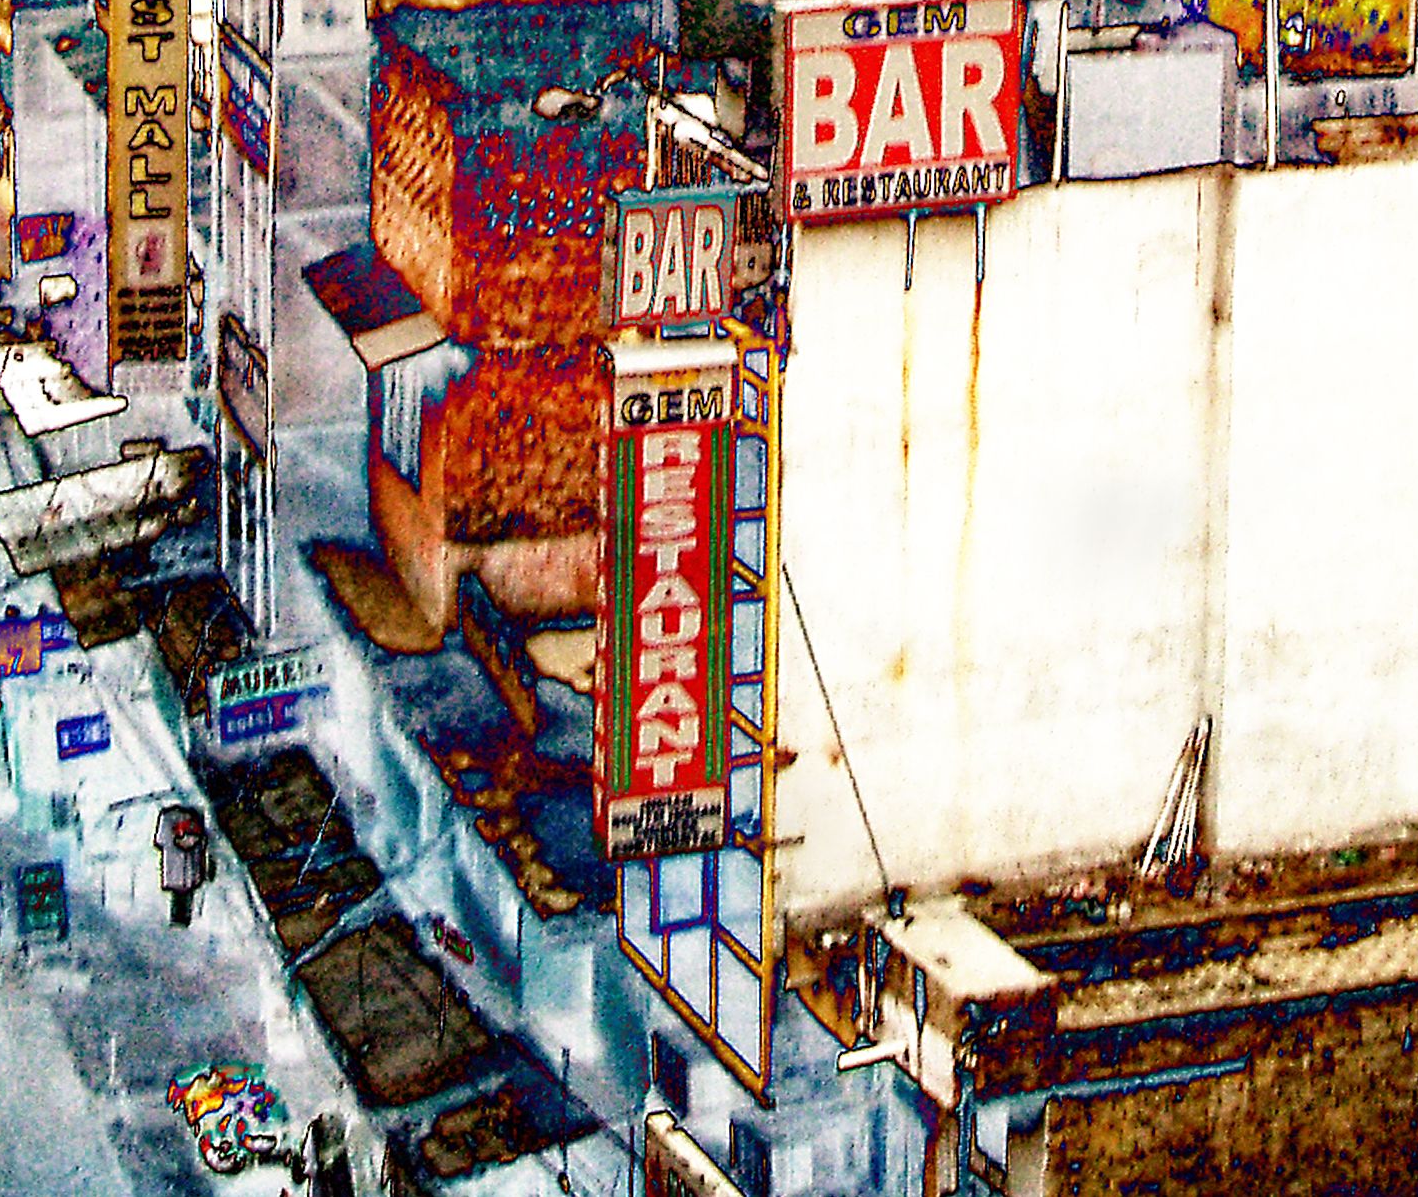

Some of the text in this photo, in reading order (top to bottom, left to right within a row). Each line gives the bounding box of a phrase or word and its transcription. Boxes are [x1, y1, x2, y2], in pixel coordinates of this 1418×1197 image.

[843, 3, 967, 38] GEM
[124, 85, 178, 220] MALL
[793, 39, 1009, 171] BAR
[793, 163, 1008, 210] & RESTAURANT
[621, 205, 726, 319] BAR
[621, 386, 724, 425] GEM
[636, 431, 702, 790] RESTAURANT
